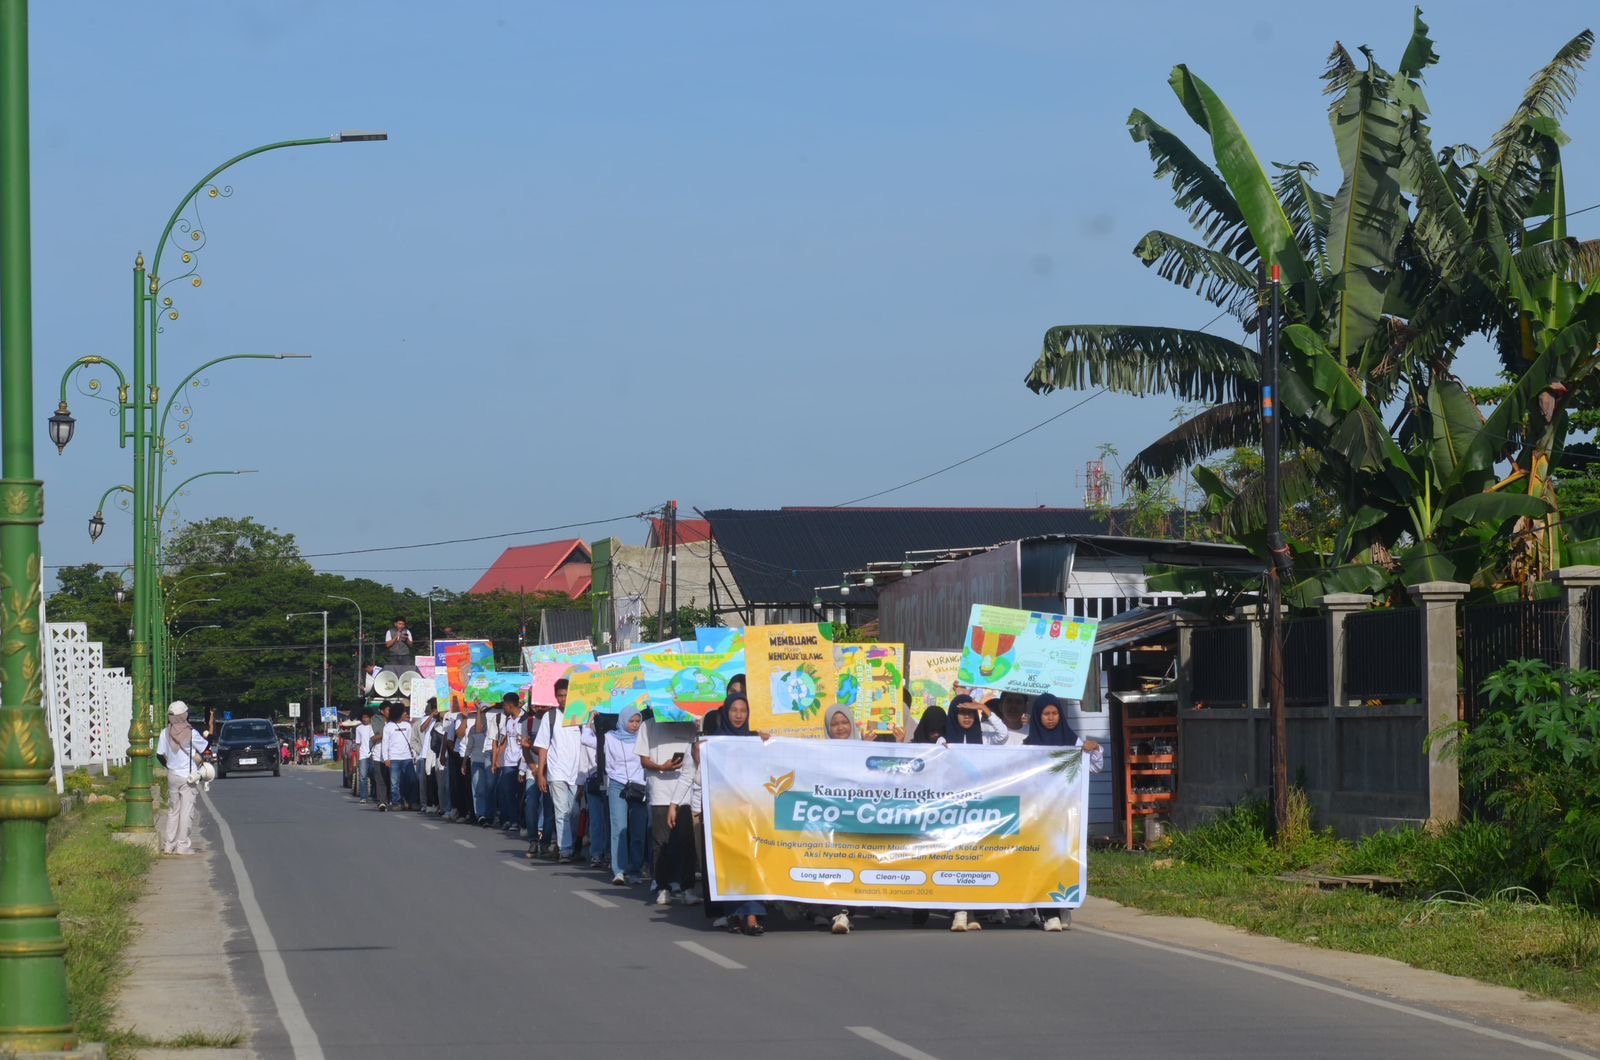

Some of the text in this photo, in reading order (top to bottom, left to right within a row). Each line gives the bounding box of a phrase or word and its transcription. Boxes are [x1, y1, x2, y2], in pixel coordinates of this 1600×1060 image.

[769, 636, 818, 647] MEMBUANG
[814, 785, 891, 803] Kampanye
[777, 840, 824, 851] Lingkungan
[861, 843, 886, 851] Kaum
[979, 844, 1009, 852] Kendari
[804, 850, 821, 859] Aksi
[823, 851, 847, 861] Nyata
[848, 852, 856, 860] di
[928, 853, 953, 861] Media
[801, 872, 842, 880] Long March
[875, 873, 911, 882] Clean-Up
[940, 872, 991, 880] Eco-Campaign
[890, 888, 915, 896] Januari
